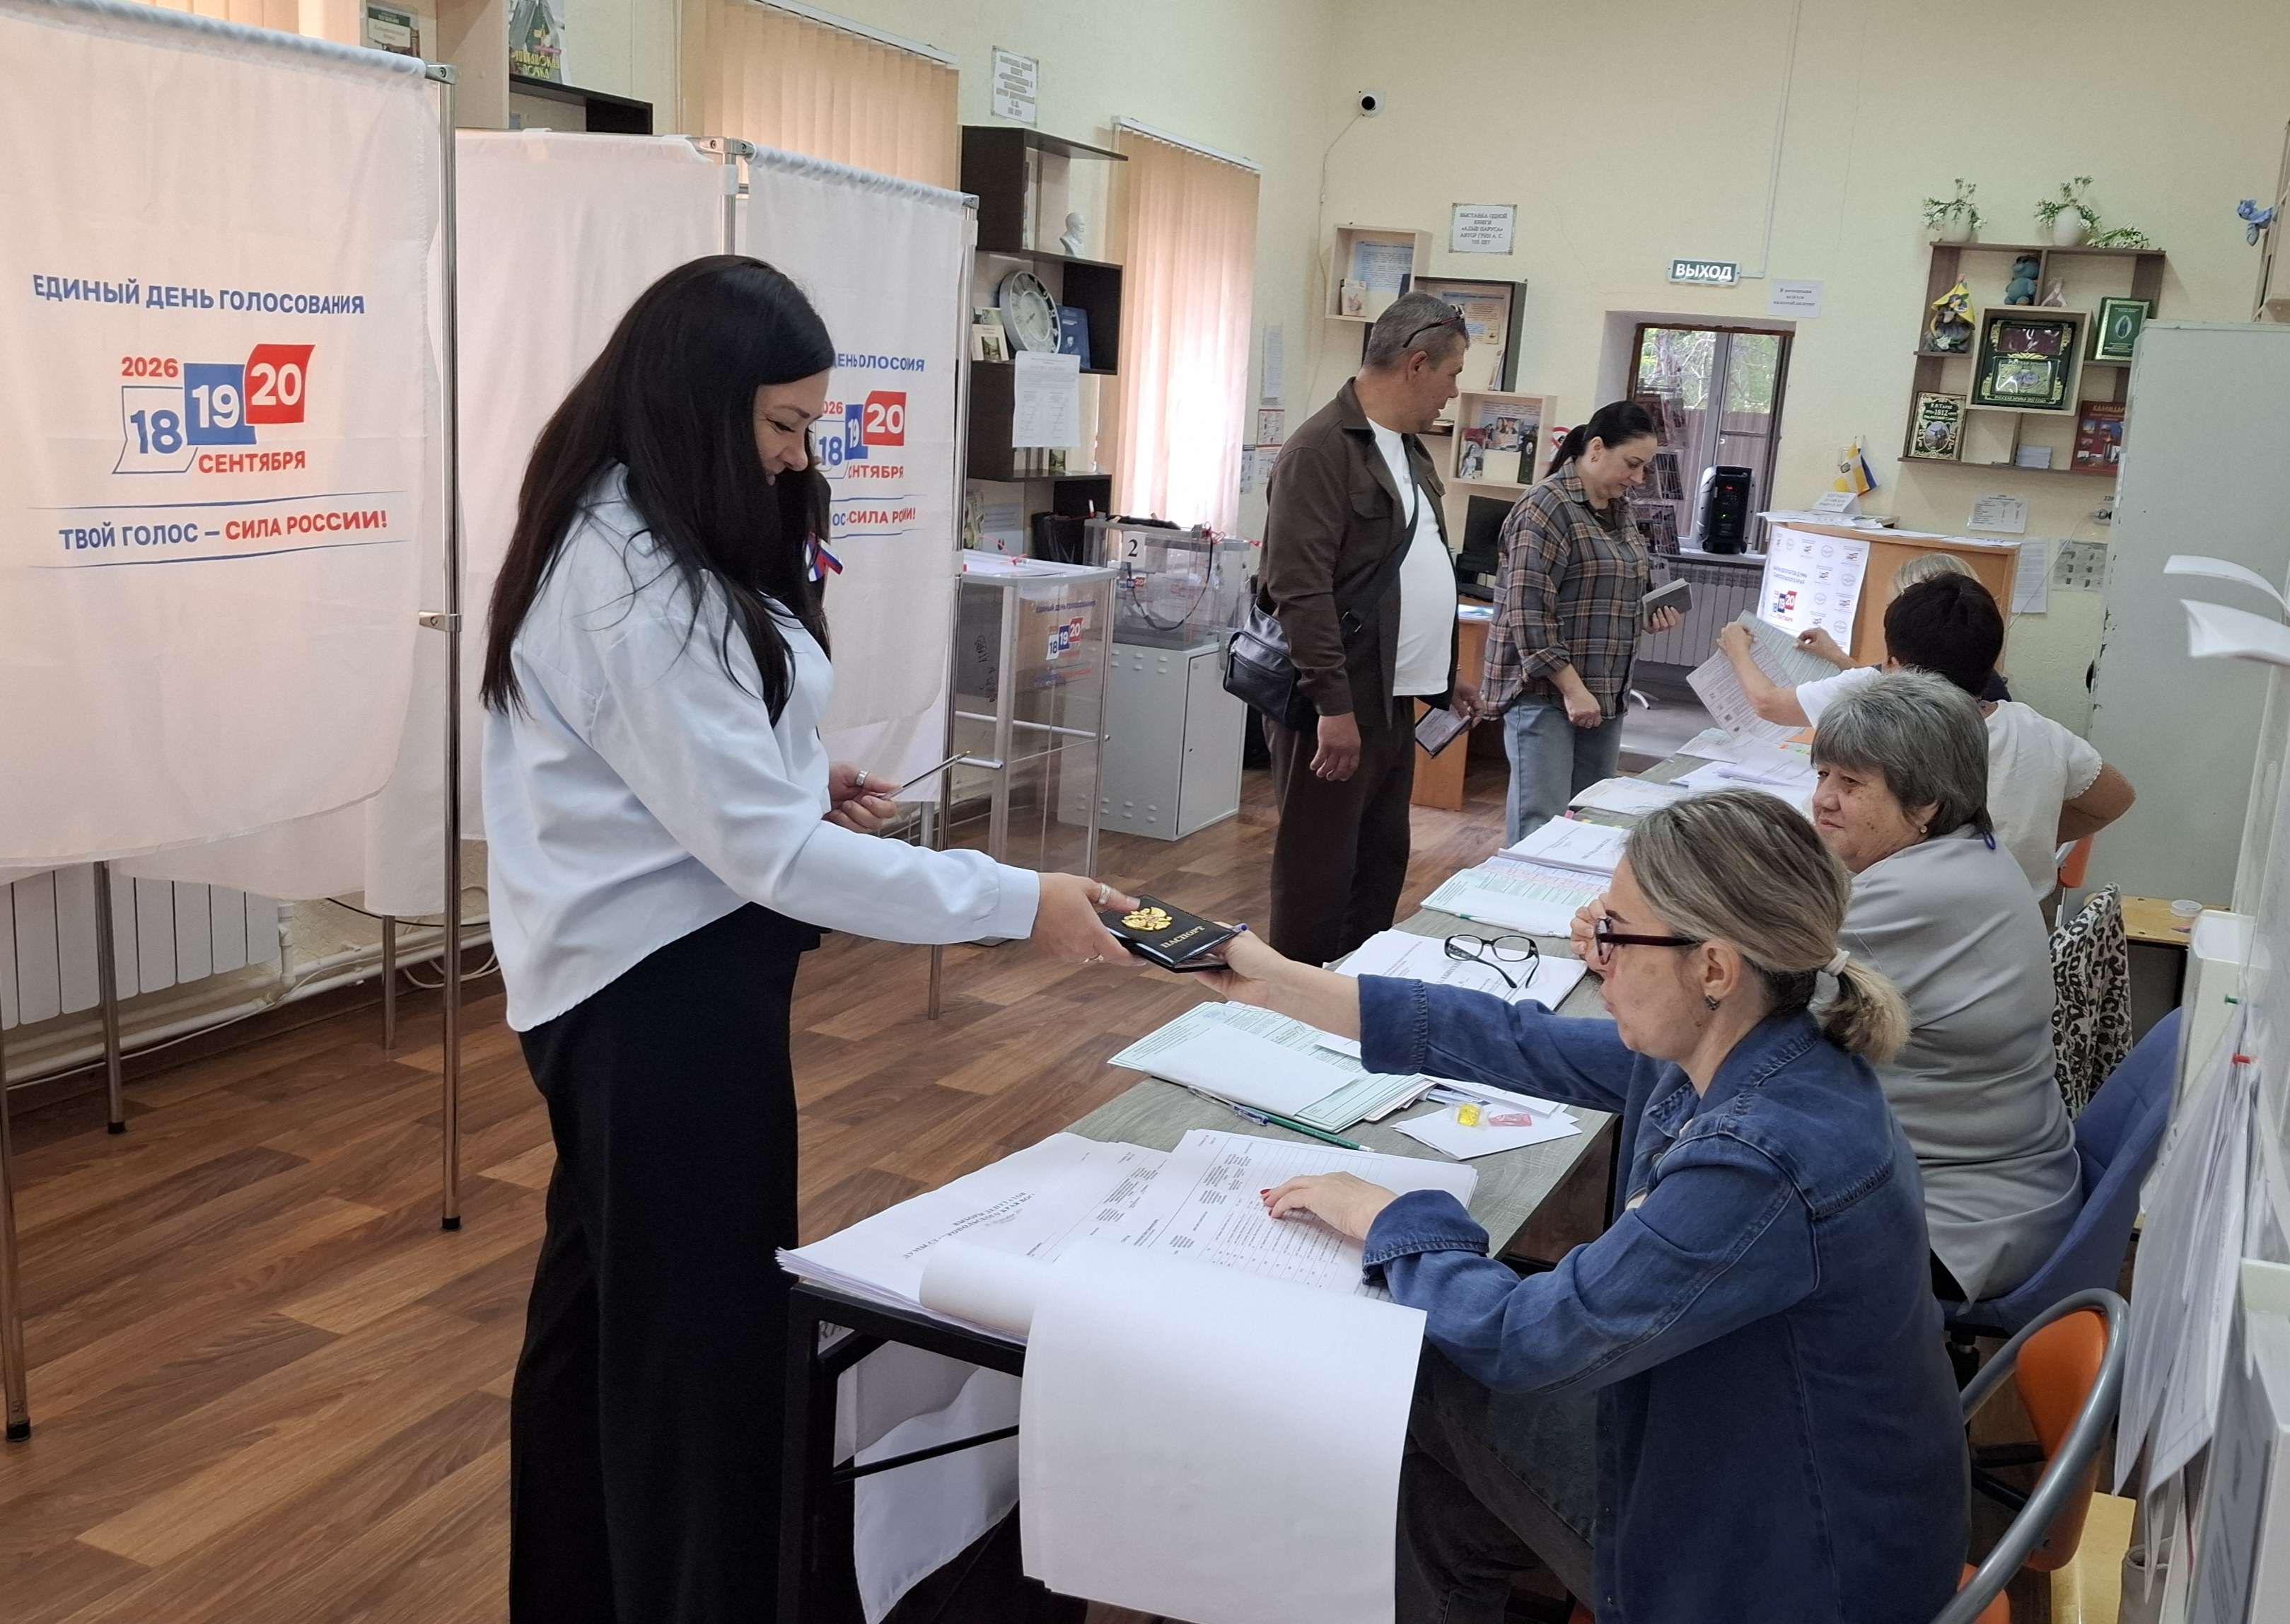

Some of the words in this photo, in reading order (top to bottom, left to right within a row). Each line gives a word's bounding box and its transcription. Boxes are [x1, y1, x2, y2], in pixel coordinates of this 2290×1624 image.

[1675, 263, 1732, 281] ВЫХОД
[33, 274, 140, 305] ЕДИНЫЙ
[145, 284, 214, 310] ДЕНЬ
[219, 289, 365, 315] ГОЛОСОВАНИЯ
[122, 356, 179, 378] 2026
[835, 353, 858, 369] ЕНЬ
[130, 410, 183, 454] 18
[192, 384, 240, 429] 19
[250, 362, 302, 406] 20
[823, 401, 843, 414] 026
[818, 436, 842, 466] 18
[848, 418, 860, 448] 19
[866, 402, 904, 434] 20
[198, 451, 306, 474] СЕНТЯБРЯ
[848, 465, 904, 479] СНТЯБРЯ
[849, 511, 889, 524] СИЛА
[59, 521, 115, 550] ТВОЙ
[122, 523, 199, 547] ГОЛОС
[225, 517, 282, 540] СИЛА
[286, 510, 388, 535] РОССИИ!
[1127, 538, 1139, 557] 2
[1779, 598, 1785, 610] 19
[1785, 594, 1795, 607] 20
[1050, 641, 1058, 654] 18
[1060, 631, 1069, 645] 19
[1070, 622, 1081, 637] 20
[1160, 925, 1206, 949] ПАСПОРТ
[952, 1212, 985, 1226] ВЫБОРЫ
[985, 1192, 1027, 1214] ДЕПУТАТОВ
[902, 1243, 929, 1259] ДУМЫ
[928, 1212, 1001, 1246] СТРОПОЛЬСКОГО
[1000, 1202, 1021, 1213] КРАЯ
